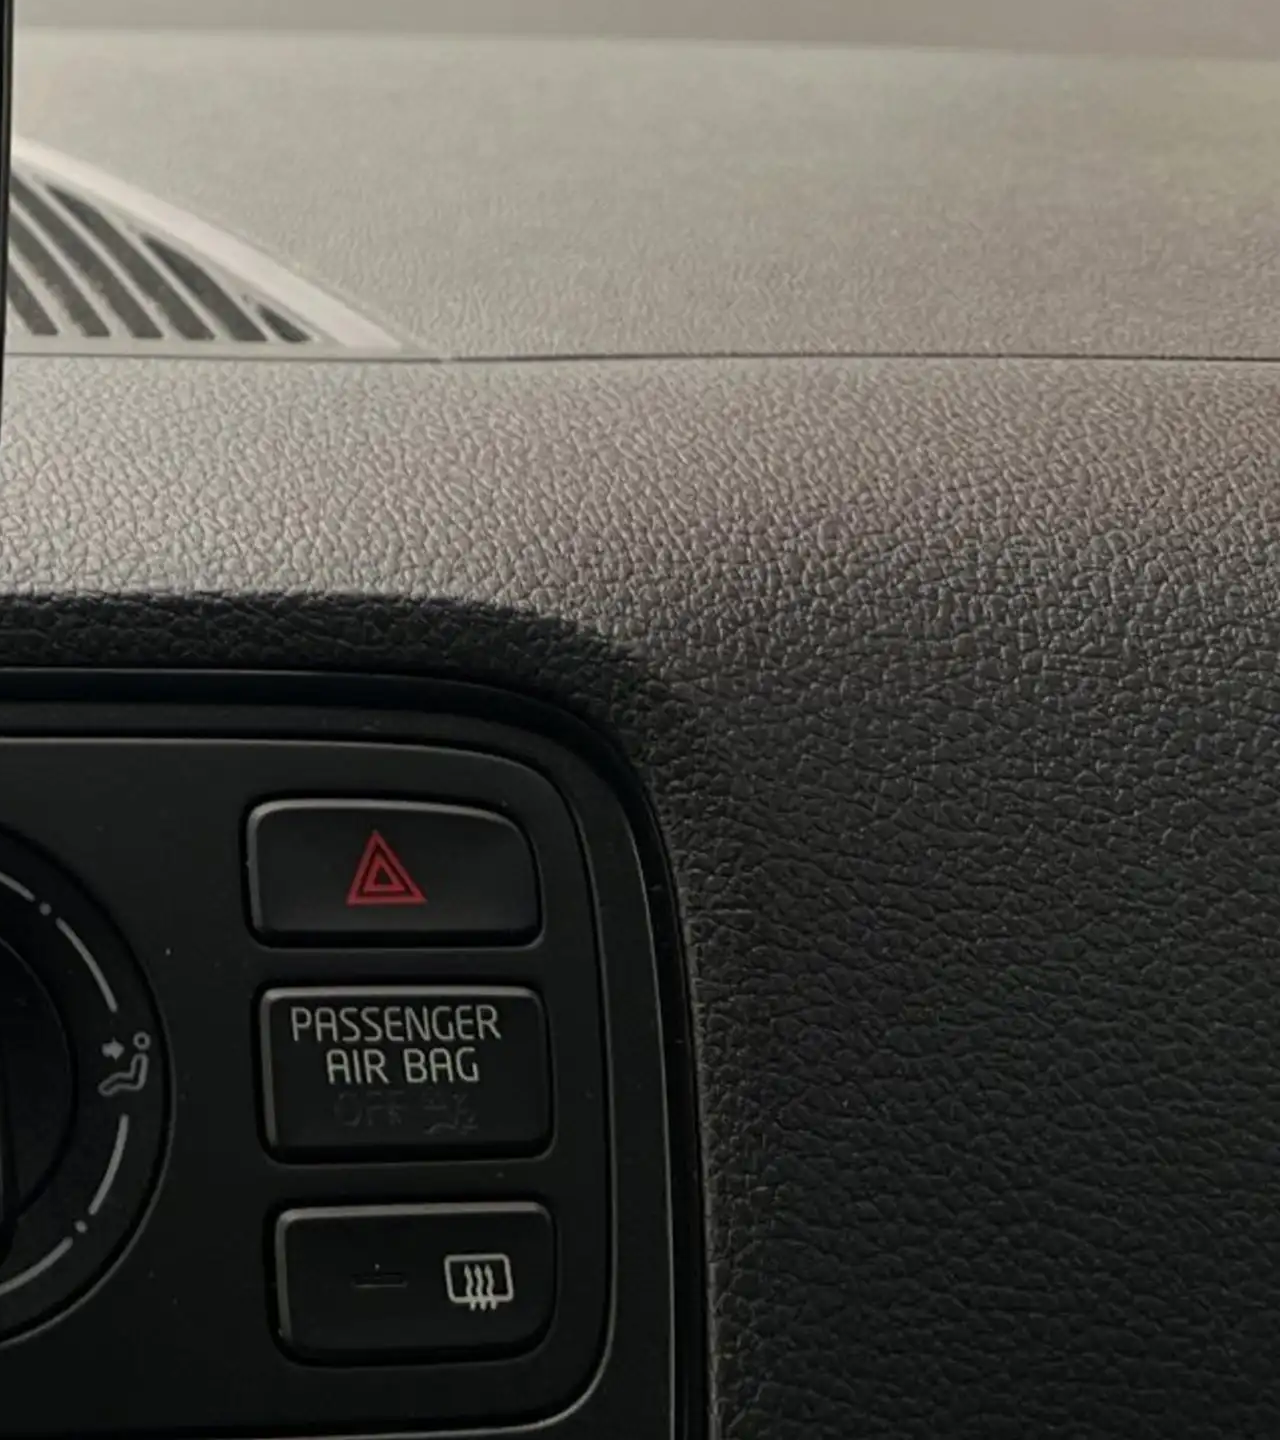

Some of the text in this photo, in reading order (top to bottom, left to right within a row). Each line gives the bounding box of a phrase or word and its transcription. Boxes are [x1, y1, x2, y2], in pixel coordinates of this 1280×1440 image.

[290, 1003, 502, 1043] PASSENGER
[325, 1046, 481, 1085] AIR BAG
